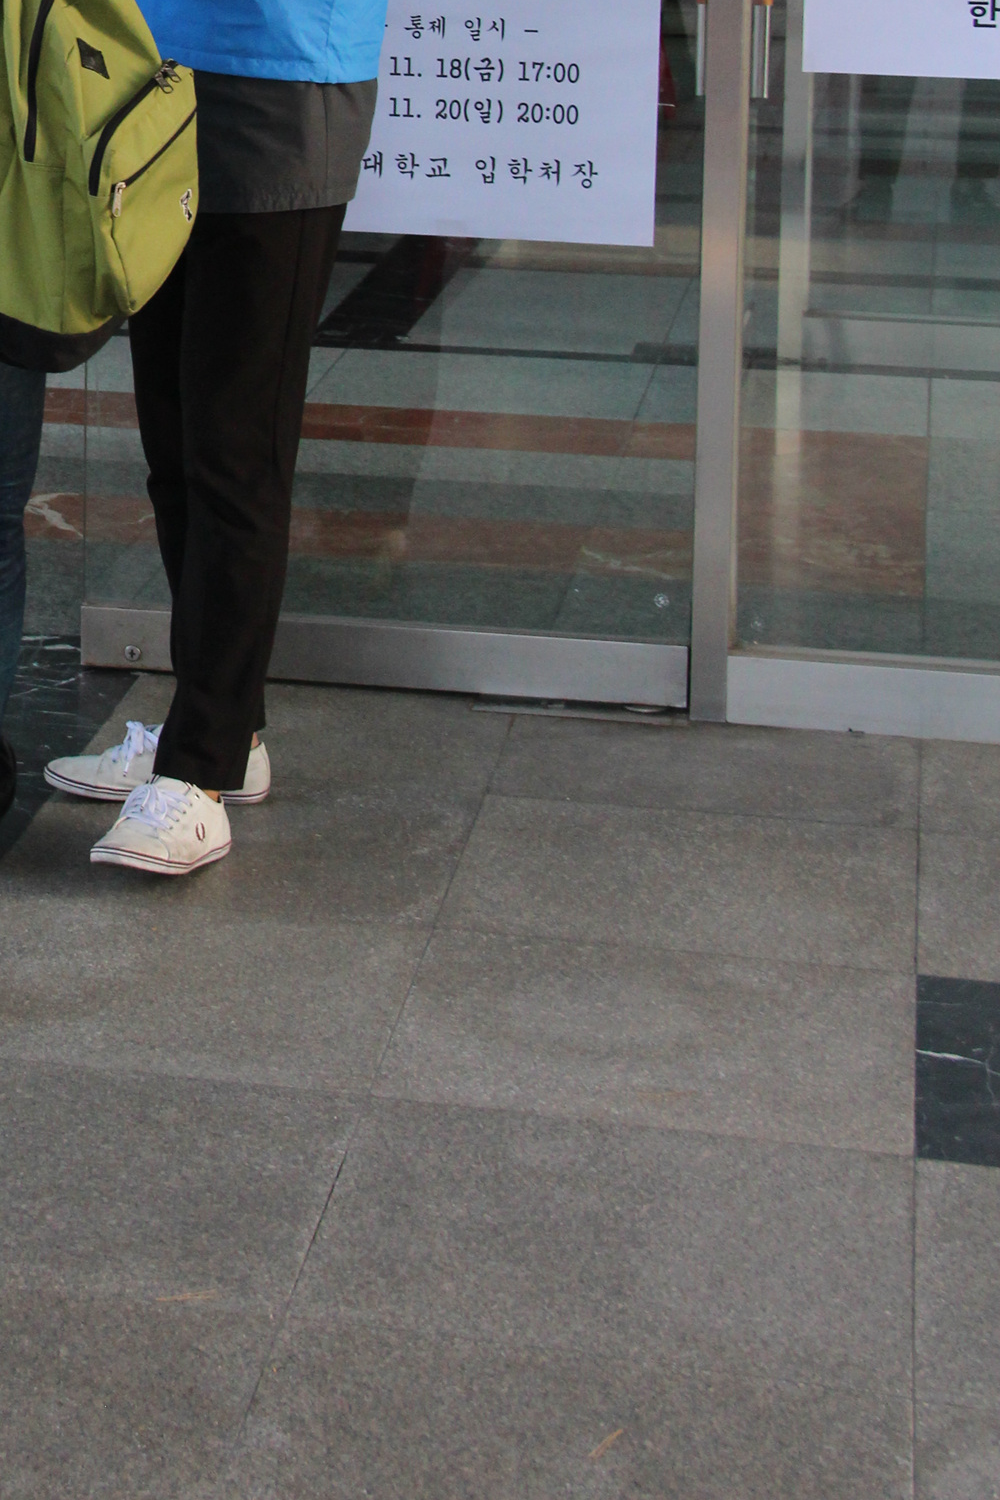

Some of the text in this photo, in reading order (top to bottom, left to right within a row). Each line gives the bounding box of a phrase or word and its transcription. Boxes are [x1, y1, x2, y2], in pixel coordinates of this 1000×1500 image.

[404, 15, 446, 39] 통제
[464, 17, 506, 41] 일시
[389, 56, 580, 84] 11. 18(금) 17:00
[389, 97, 579, 125] 11. 20(일) 20:00
[362, 150, 599, 190] 대학교 입학처장
